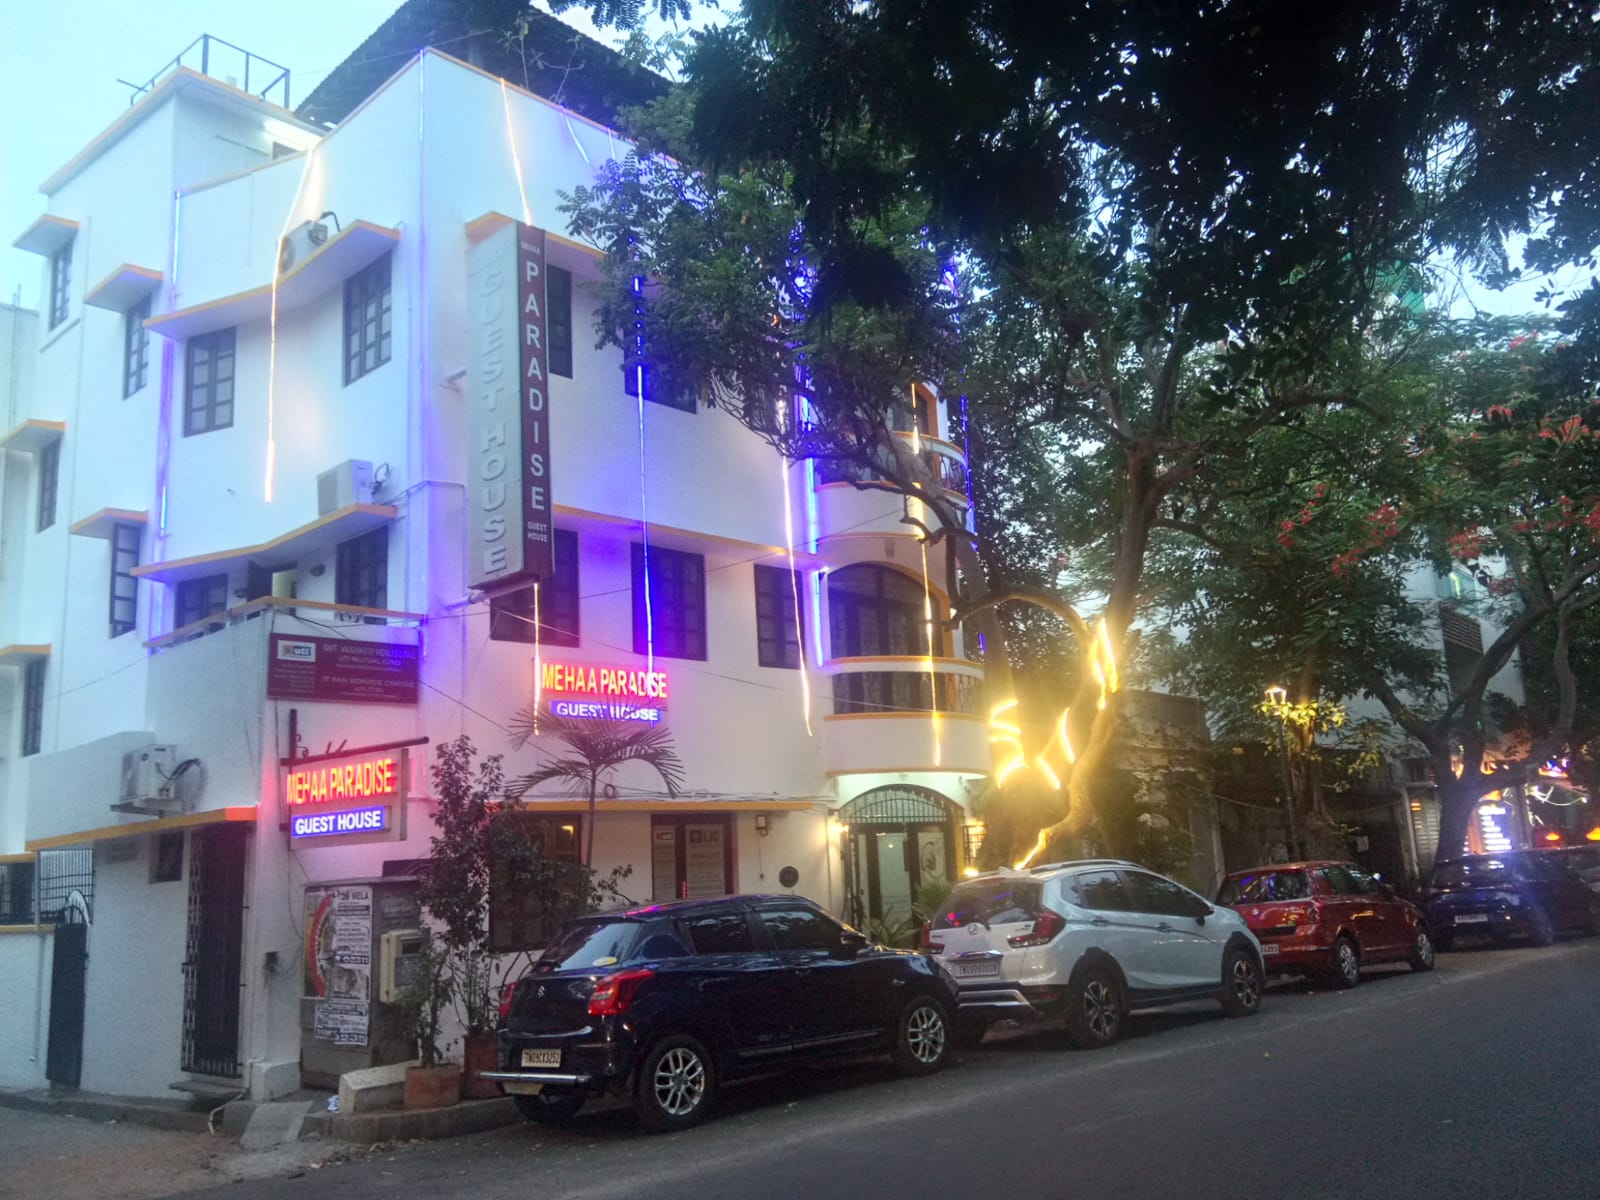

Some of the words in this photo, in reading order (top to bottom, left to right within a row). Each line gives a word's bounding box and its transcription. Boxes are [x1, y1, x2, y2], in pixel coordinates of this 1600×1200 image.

[479, 267, 506, 414] GUEST
[524, 260, 546, 511] PARADISE
[480, 419, 508, 577] HOUSE
[527, 520, 548, 532] GUEST
[527, 532, 549, 543] HOUSE
[542, 663, 598, 694] MEHAA
[601, 668, 668, 698] PARADISE
[556, 702, 607, 718] GUEST
[287, 768, 328, 805] MEHAA
[330, 758, 392, 798] PARADISE
[295, 815, 336, 835] GUEST
[338, 810, 381, 831] HOUSE
